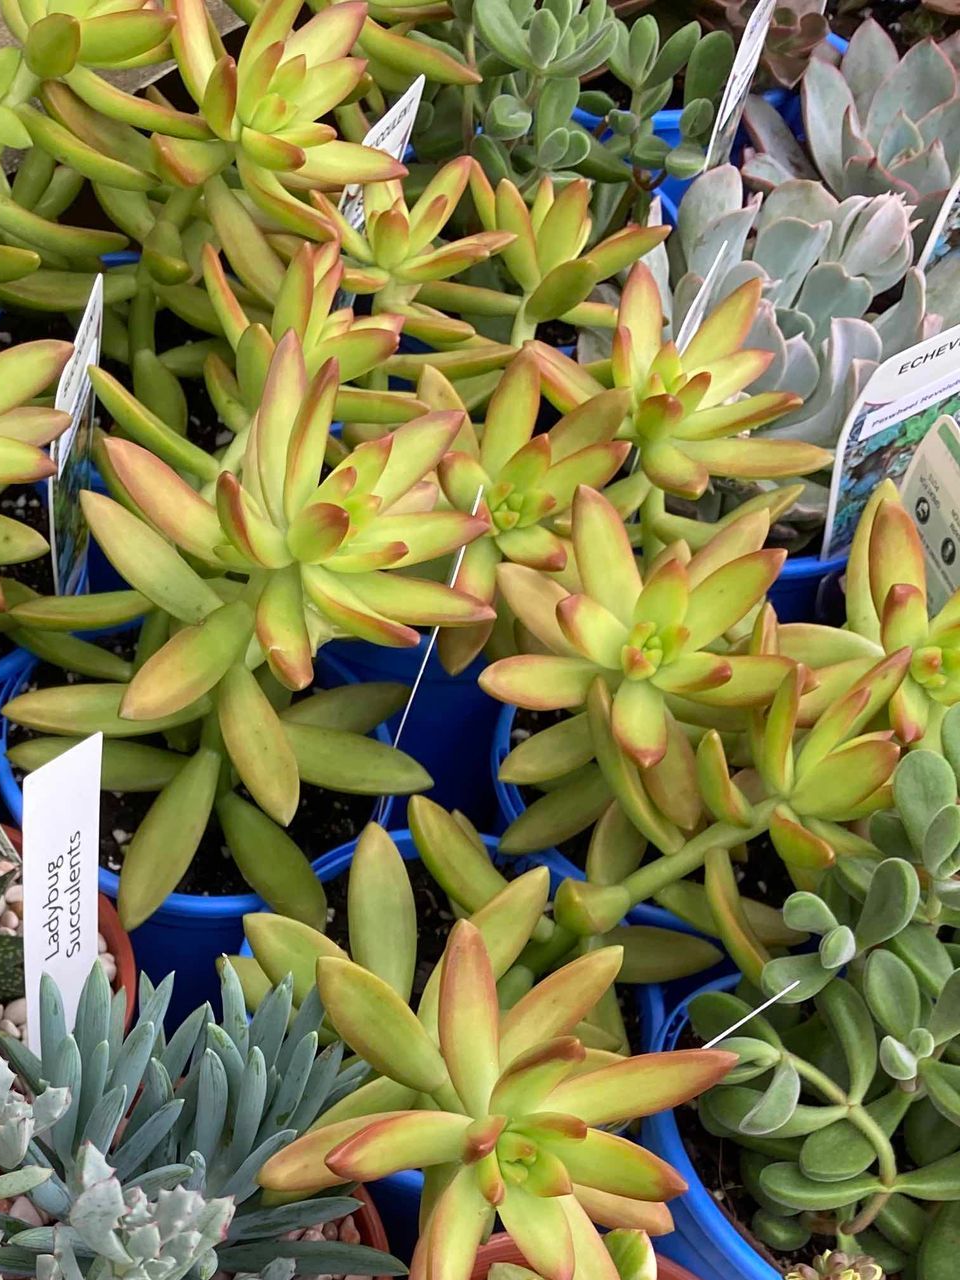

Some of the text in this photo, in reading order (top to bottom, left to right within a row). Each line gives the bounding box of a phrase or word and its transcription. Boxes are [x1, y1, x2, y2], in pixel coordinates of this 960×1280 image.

[898, 338, 960, 376] ECHEV
[42, 854, 64, 962] Ladybug
[64, 830, 81, 959] Succulents
